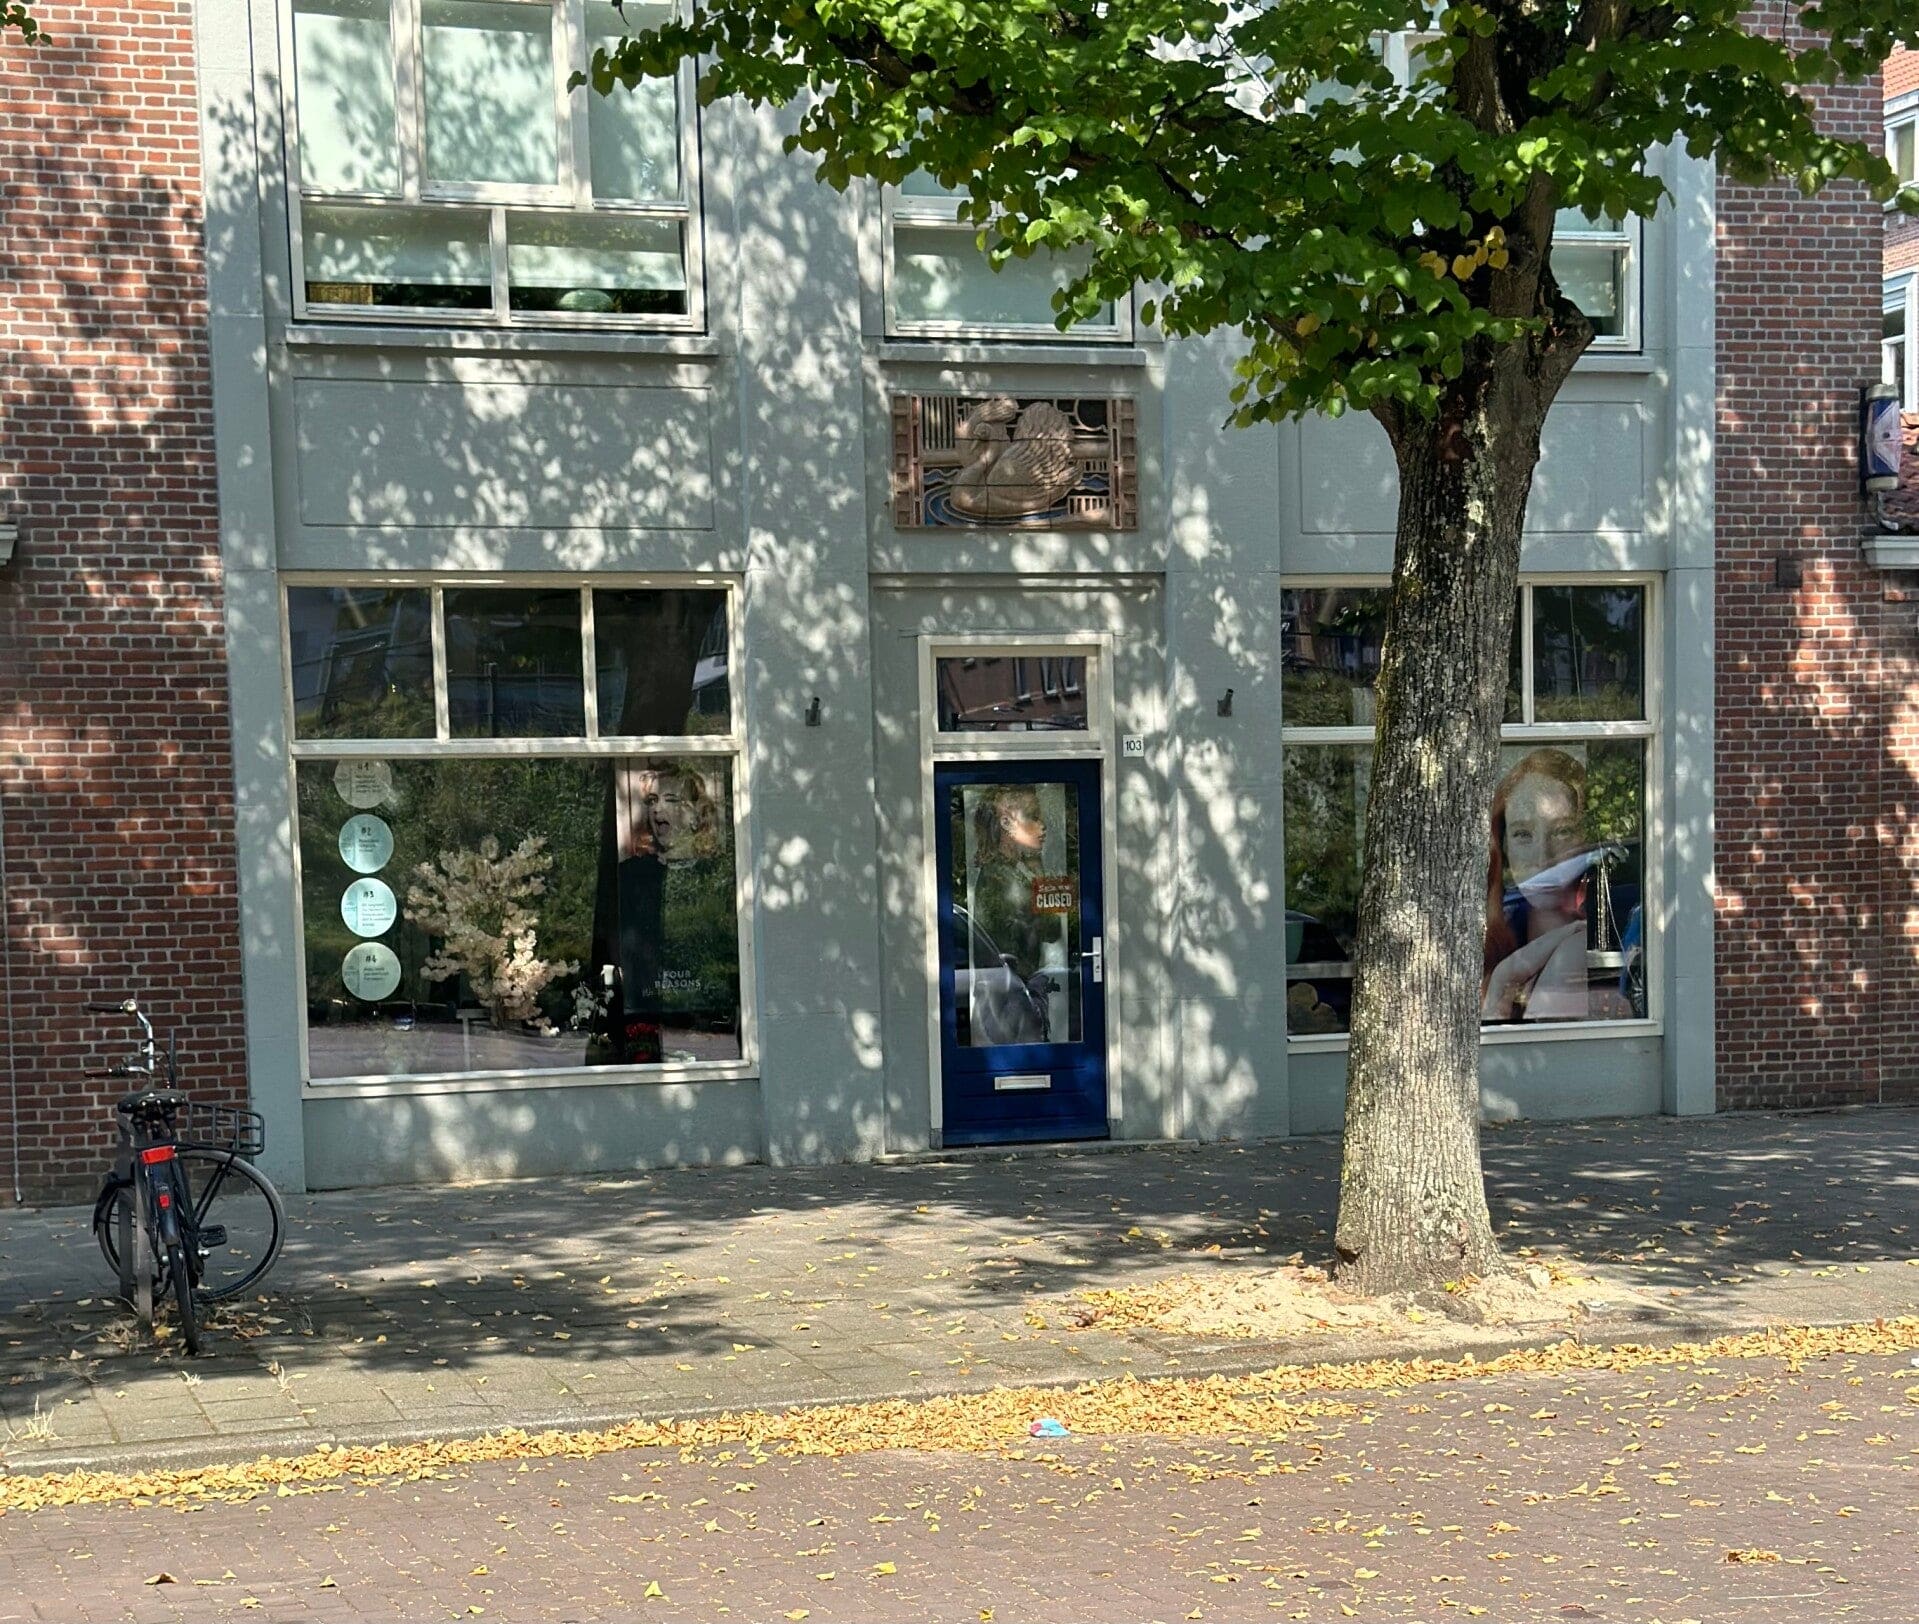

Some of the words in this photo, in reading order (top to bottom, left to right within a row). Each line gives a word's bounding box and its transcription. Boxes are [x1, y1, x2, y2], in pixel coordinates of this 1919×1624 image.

[1126, 740, 1142, 751] 103
[1036, 892, 1072, 908] CLOSED
[662, 970, 691, 979] FOUR
